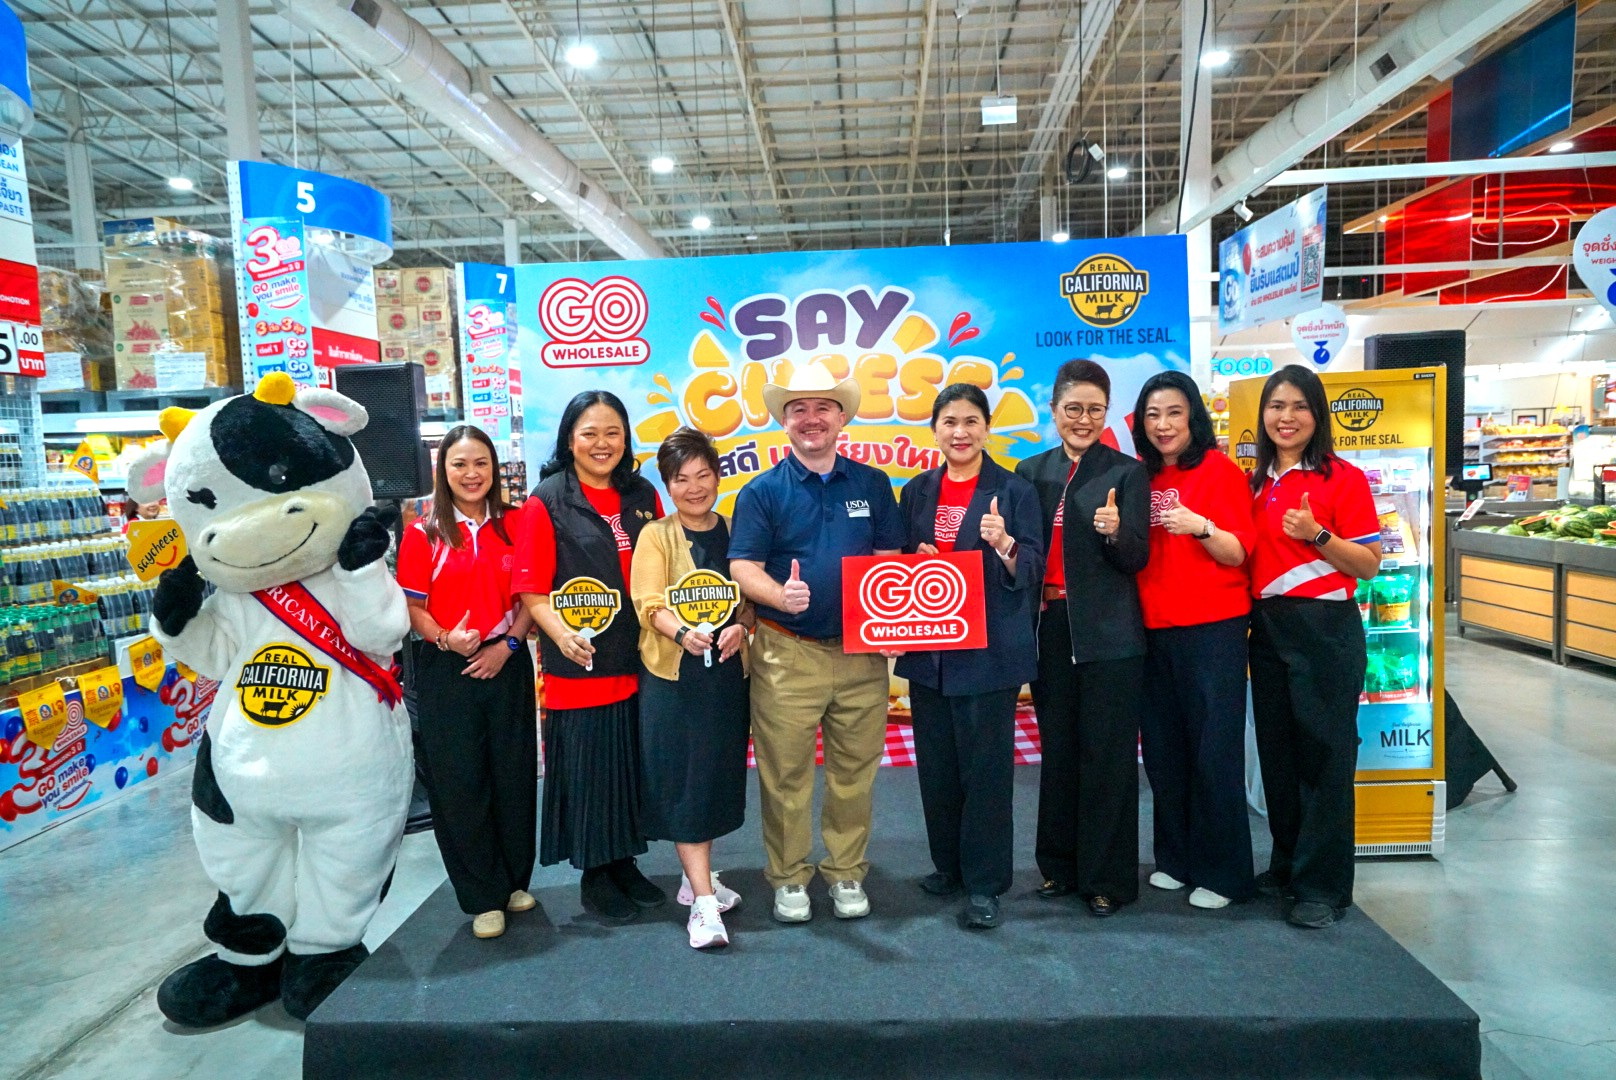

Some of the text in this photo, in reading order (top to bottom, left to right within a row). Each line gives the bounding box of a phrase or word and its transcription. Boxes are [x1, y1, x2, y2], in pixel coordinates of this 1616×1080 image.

[0, 159, 19, 172] EAN
[296, 181, 316, 213] 5
[246, 225, 282, 274] 3
[1089, 263, 1118, 272] REAL
[253, 276, 297, 294] GO make
[496, 273, 508, 294] 7
[1065, 274, 1144, 294] CALIFORNIA
[256, 292, 273, 302] you
[275, 283, 300, 296] smile
[1085, 293, 1124, 304] MILK
[538, 275, 649, 343] GO
[255, 321, 268, 336] 3
[281, 317, 293, 333] 3
[734, 289, 909, 361] SAY
[20, 332, 38, 345] .00
[286, 337, 308, 350] Go
[1035, 327, 1176, 347] LOOK FOR THE SEAL.
[552, 345, 640, 361] WHOLESALE
[288, 360, 309, 372] Go
[1331, 399, 1382, 412] CALIFORNIA
[1339, 436, 1357, 447] FOR
[1357, 434, 1377, 446] THE
[1378, 433, 1404, 445] SEAL.
[845, 500, 870, 509] USDA
[137, 528, 179, 573] saycheese
[690, 578, 713, 586] REAL
[671, 587, 735, 604] CALIFORNIA
[859, 559, 967, 623] GO
[266, 586, 320, 632] RICAN
[555, 594, 616, 608] CALIFORNIA
[688, 601, 719, 611] MILK
[571, 607, 601, 616] MILK
[871, 623, 958, 638] WHOLESALE
[264, 653, 298, 664] REAL
[240, 664, 324, 690] CALIFORNIA
[252, 687, 299, 701] MILK
[1380, 728, 1431, 748] MILK
[38, 776, 56, 797] GO
[58, 757, 85, 783] make
[41, 787, 60, 809] you
[62, 767, 89, 791] smile
